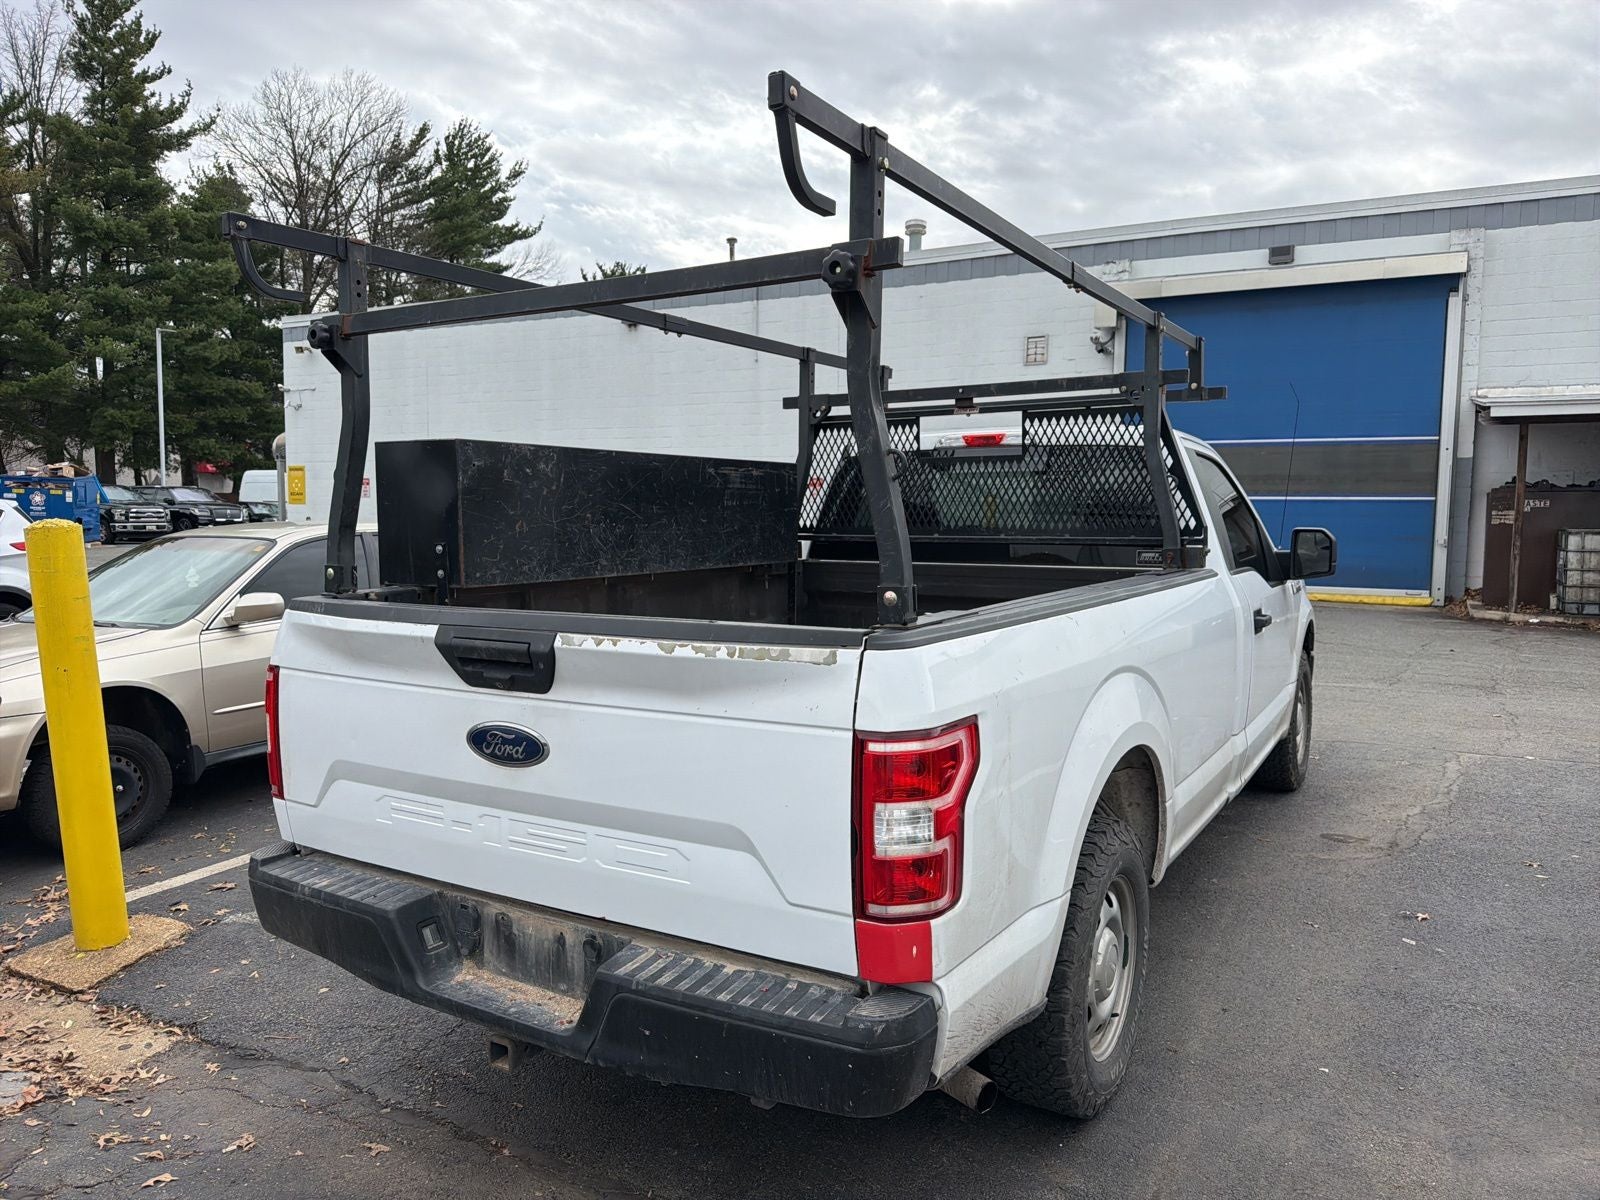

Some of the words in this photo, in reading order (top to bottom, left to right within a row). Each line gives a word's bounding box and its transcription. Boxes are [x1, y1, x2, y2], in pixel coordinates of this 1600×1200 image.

[1524, 499, 1550, 508] ASTE
[482, 730, 527, 759] Ford
[375, 795, 691, 884] F-150
